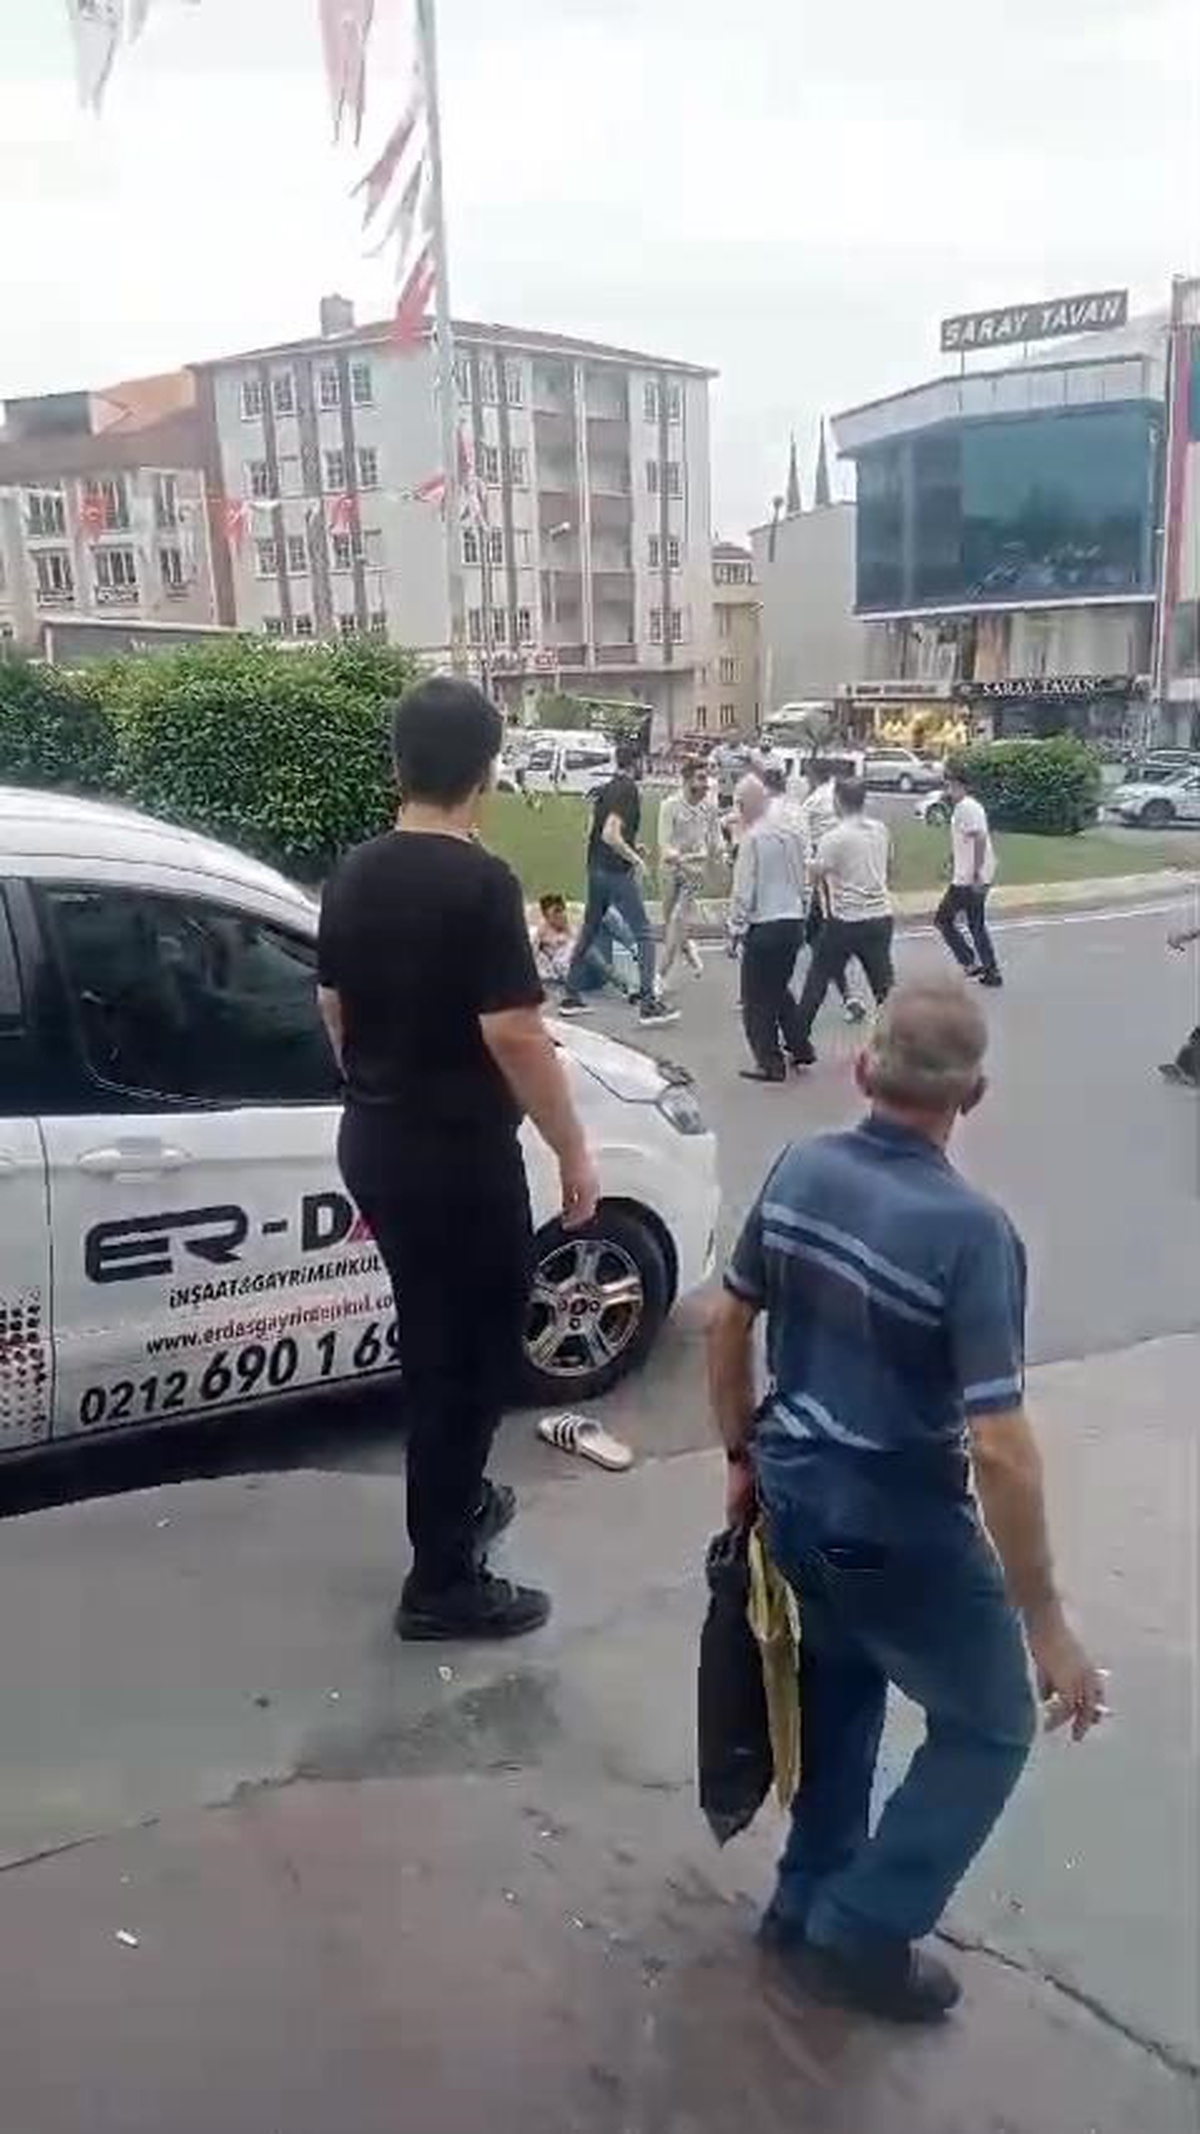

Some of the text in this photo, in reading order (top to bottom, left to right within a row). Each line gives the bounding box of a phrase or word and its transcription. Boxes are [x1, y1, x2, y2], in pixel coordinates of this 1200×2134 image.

[944, 296, 1121, 346] SARAY TAVAN
[982, 680, 1034, 696] SARAY
[146, 1294, 394, 1354] www.erdasgayrimenkul.co
[80, 1371, 188, 1425] 0212
[200, 1337, 297, 1400] 690
[317, 1330, 336, 1376] 1
